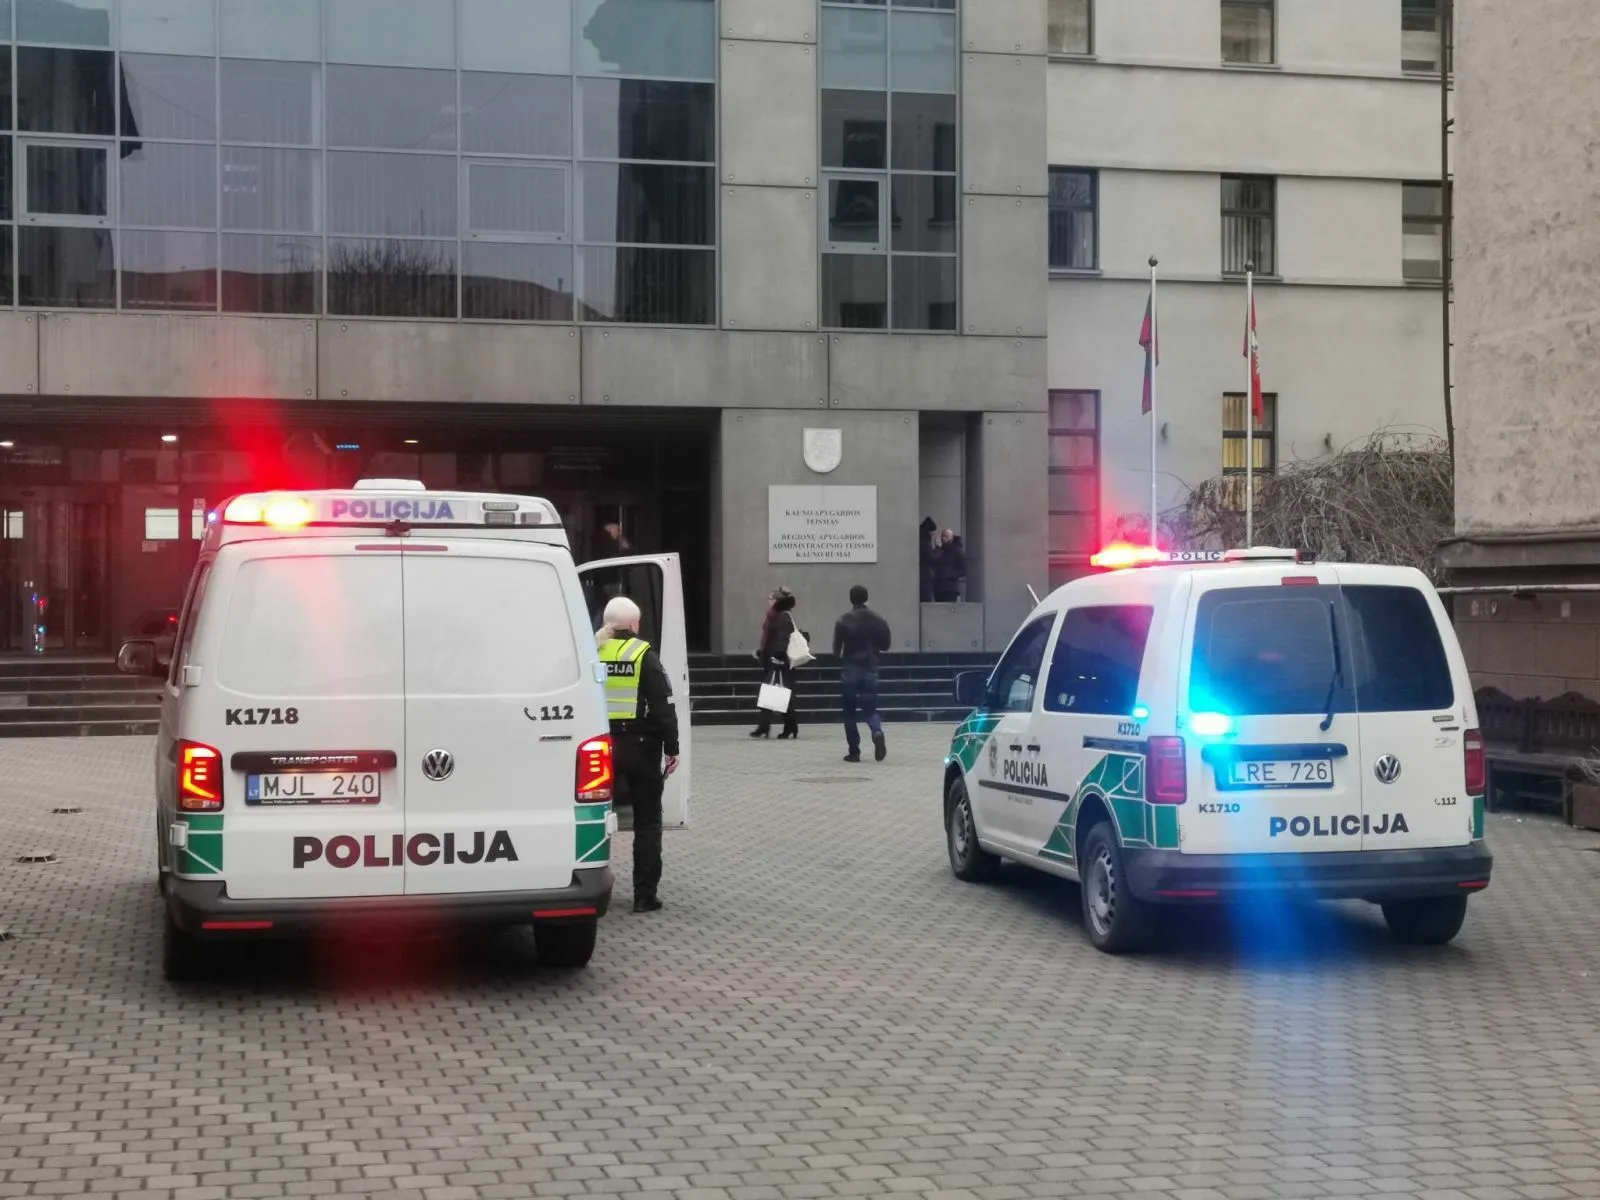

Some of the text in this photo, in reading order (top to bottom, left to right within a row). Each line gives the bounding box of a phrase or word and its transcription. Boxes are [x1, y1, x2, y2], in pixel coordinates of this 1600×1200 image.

[331, 500, 454, 520] POLICIJA
[1169, 551, 1222, 561] POLIC
[607, 664, 634, 674] CIJA
[225, 707, 299, 725] K1718
[540, 705, 574, 721] 112
[270, 756, 358, 765] TRANSPORTER
[1003, 759, 1049, 788] POLICIJA
[1231, 762, 1328, 783] LRE 726
[263, 776, 315, 796] MJL
[332, 774, 375, 795] 240
[1199, 803, 1240, 813] K1710
[1441, 797, 1457, 805] 112
[1270, 813, 1410, 837] POLICIJA
[293, 830, 519, 869] POLICIJA
